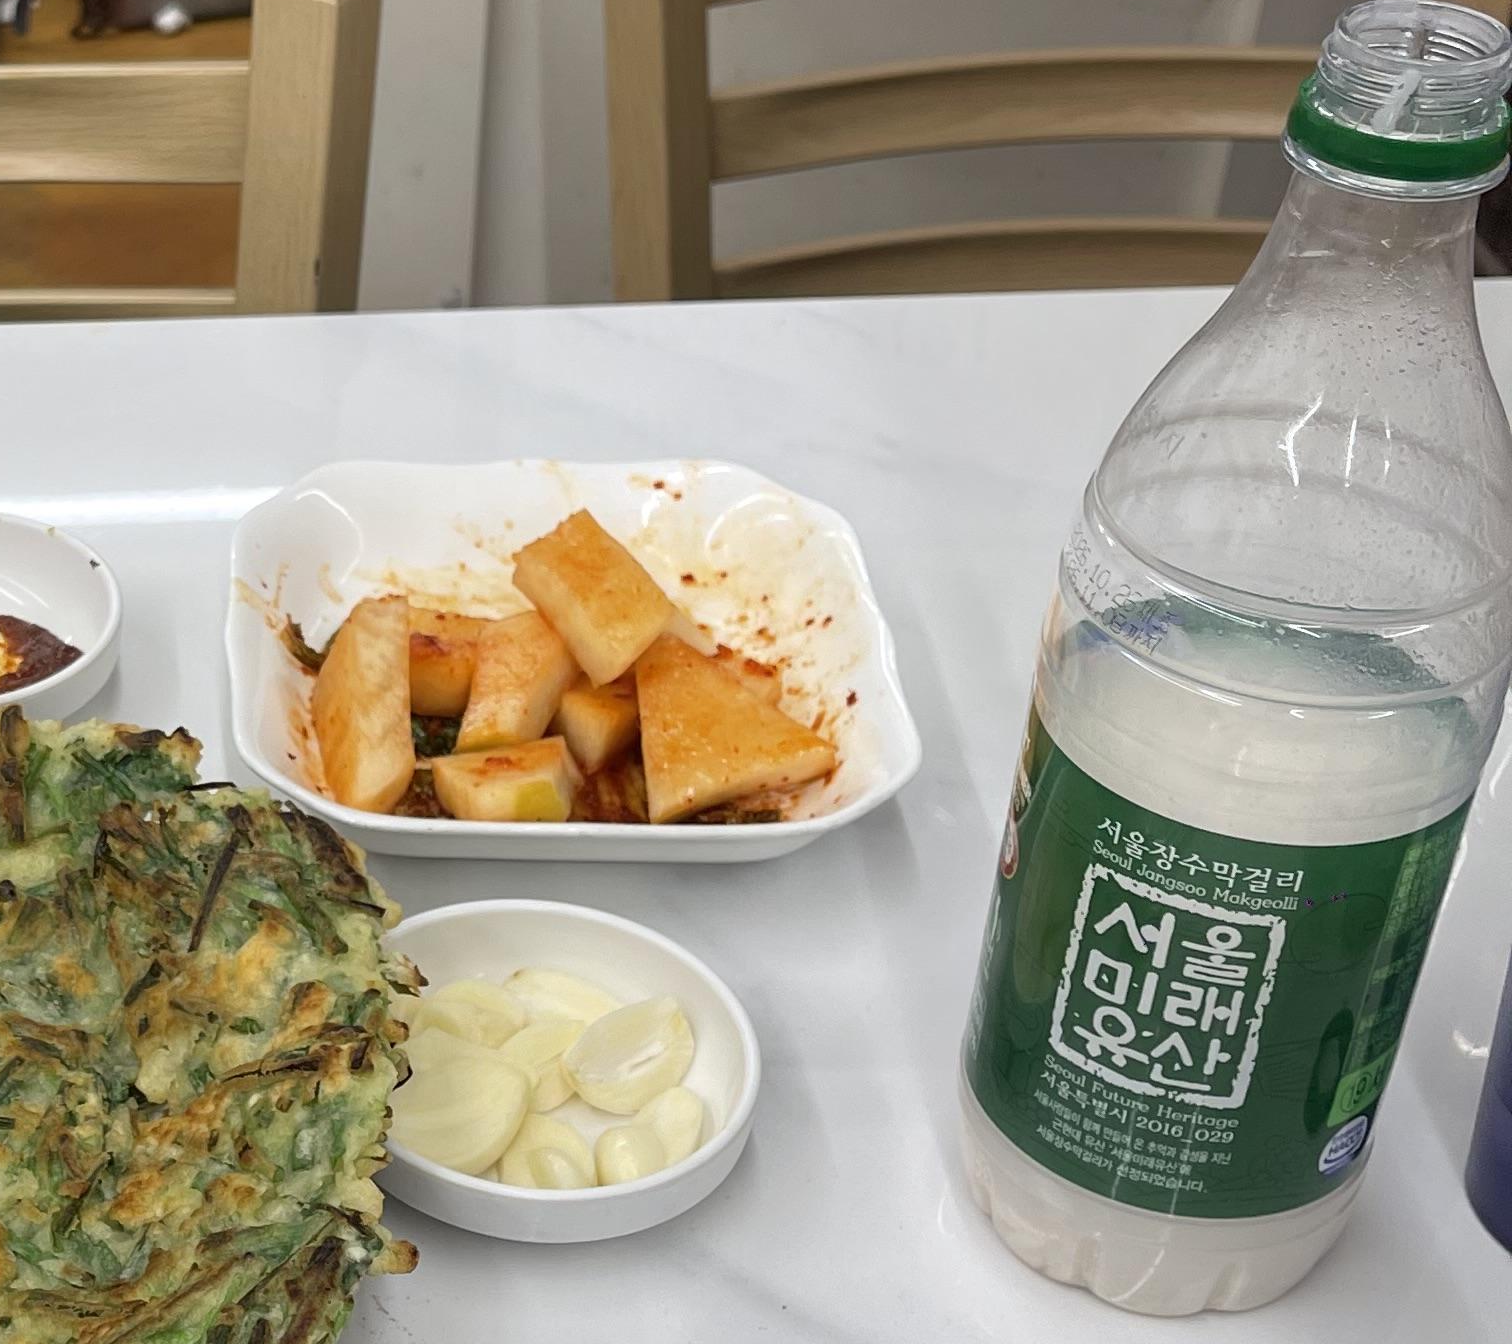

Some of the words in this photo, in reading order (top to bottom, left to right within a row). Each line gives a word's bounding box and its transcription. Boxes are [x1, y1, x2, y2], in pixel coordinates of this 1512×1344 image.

[1092, 839, 1133, 871] Seoul
[1136, 863, 1207, 897] Jangsoo
[1212, 887, 1299, 911] Makgeolli
[1097, 816, 1305, 893] 서울장수막걸리
[1093, 901, 1257, 988] 서울
[1082, 948, 1246, 1037] 미래
[1072, 1005, 1232, 1092] 유산
[1040, 1070, 1128, 1125] 서울특별시
[1135, 1115, 1236, 1145] 2016_029
[1043, 1053, 1087, 1089] Seoul
[1090, 1079, 1151, 1113] Future
[1156, 1103, 1240, 1131] Heritage
